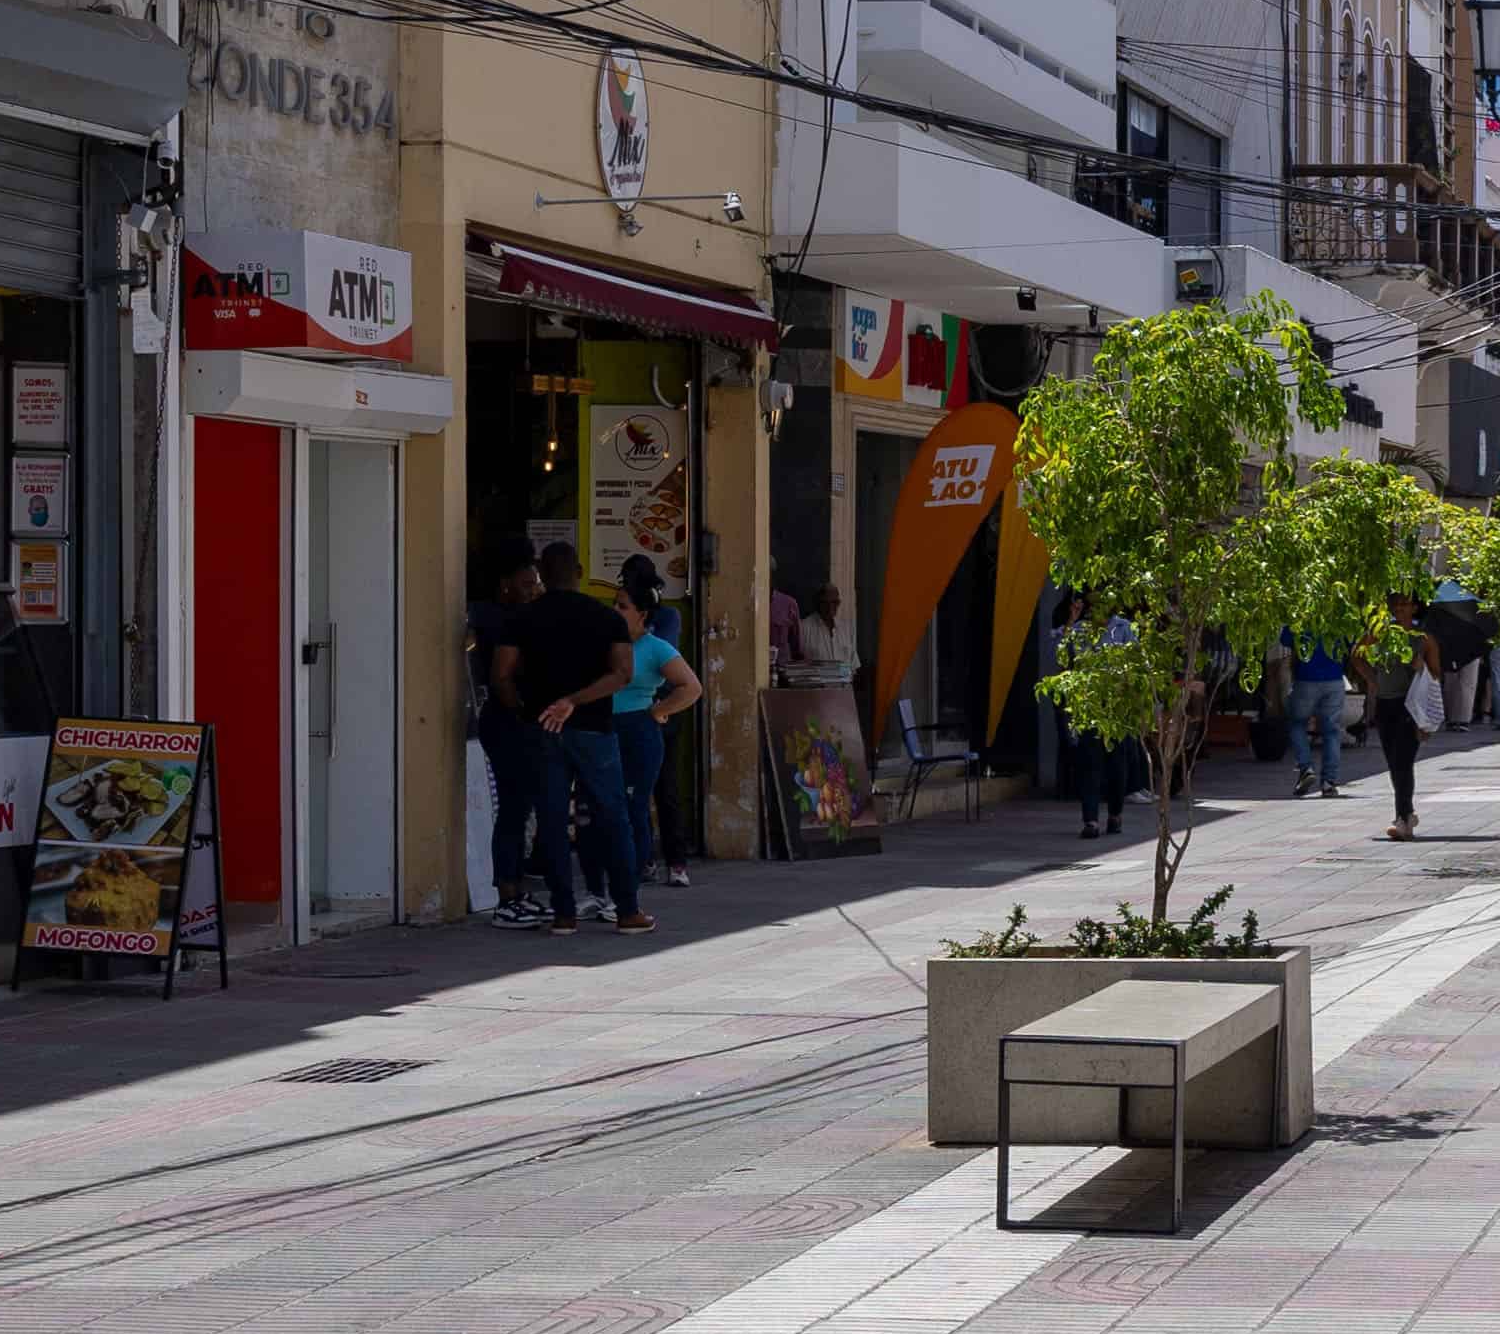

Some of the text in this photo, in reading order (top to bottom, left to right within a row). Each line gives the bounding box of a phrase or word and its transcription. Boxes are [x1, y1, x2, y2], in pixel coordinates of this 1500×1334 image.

[187, 35, 395, 139] CONDE 354
[359, 257, 378, 273] RED
[193, 271, 264, 299] ATM
[329, 269, 378, 323] ATM
[213, 309, 237, 319] VISA
[58, 728, 200, 752] CHICHARRON
[37, 927, 156, 951] MOFONGO
